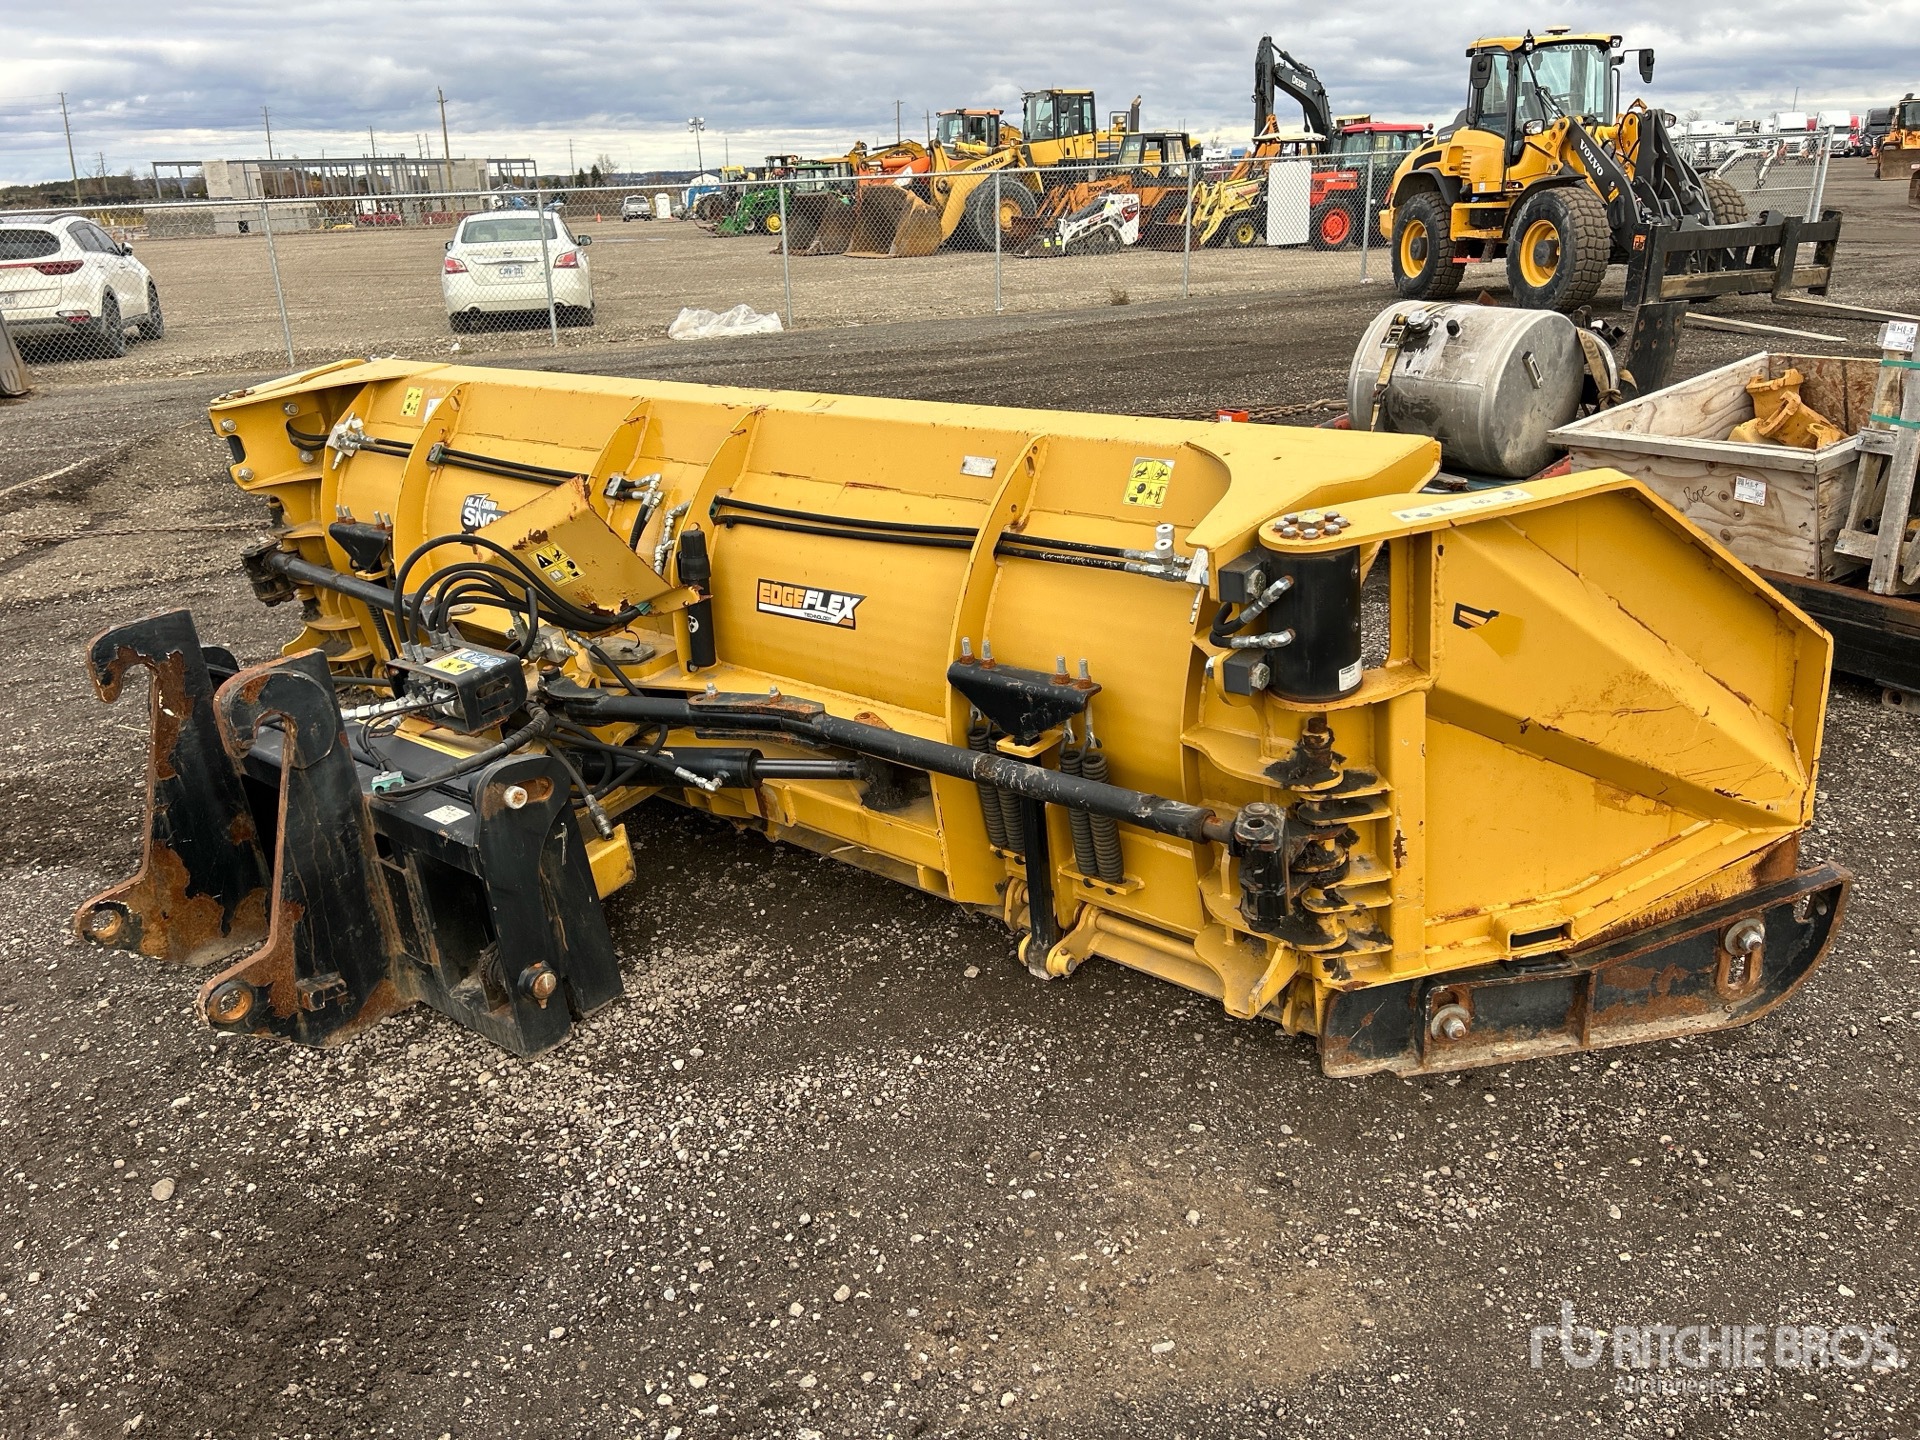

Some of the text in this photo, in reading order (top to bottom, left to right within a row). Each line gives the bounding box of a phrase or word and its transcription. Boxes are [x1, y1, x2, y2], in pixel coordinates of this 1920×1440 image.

[1554, 44, 1591, 53] VOLVO
[1579, 138, 1604, 177] VOLVO
[1683, 485, 1715, 505] Rope
[463, 507, 501, 528] SNO
[758, 582, 861, 620] EDGEFLEX
[803, 612, 832, 622] TECHNOLOGY
